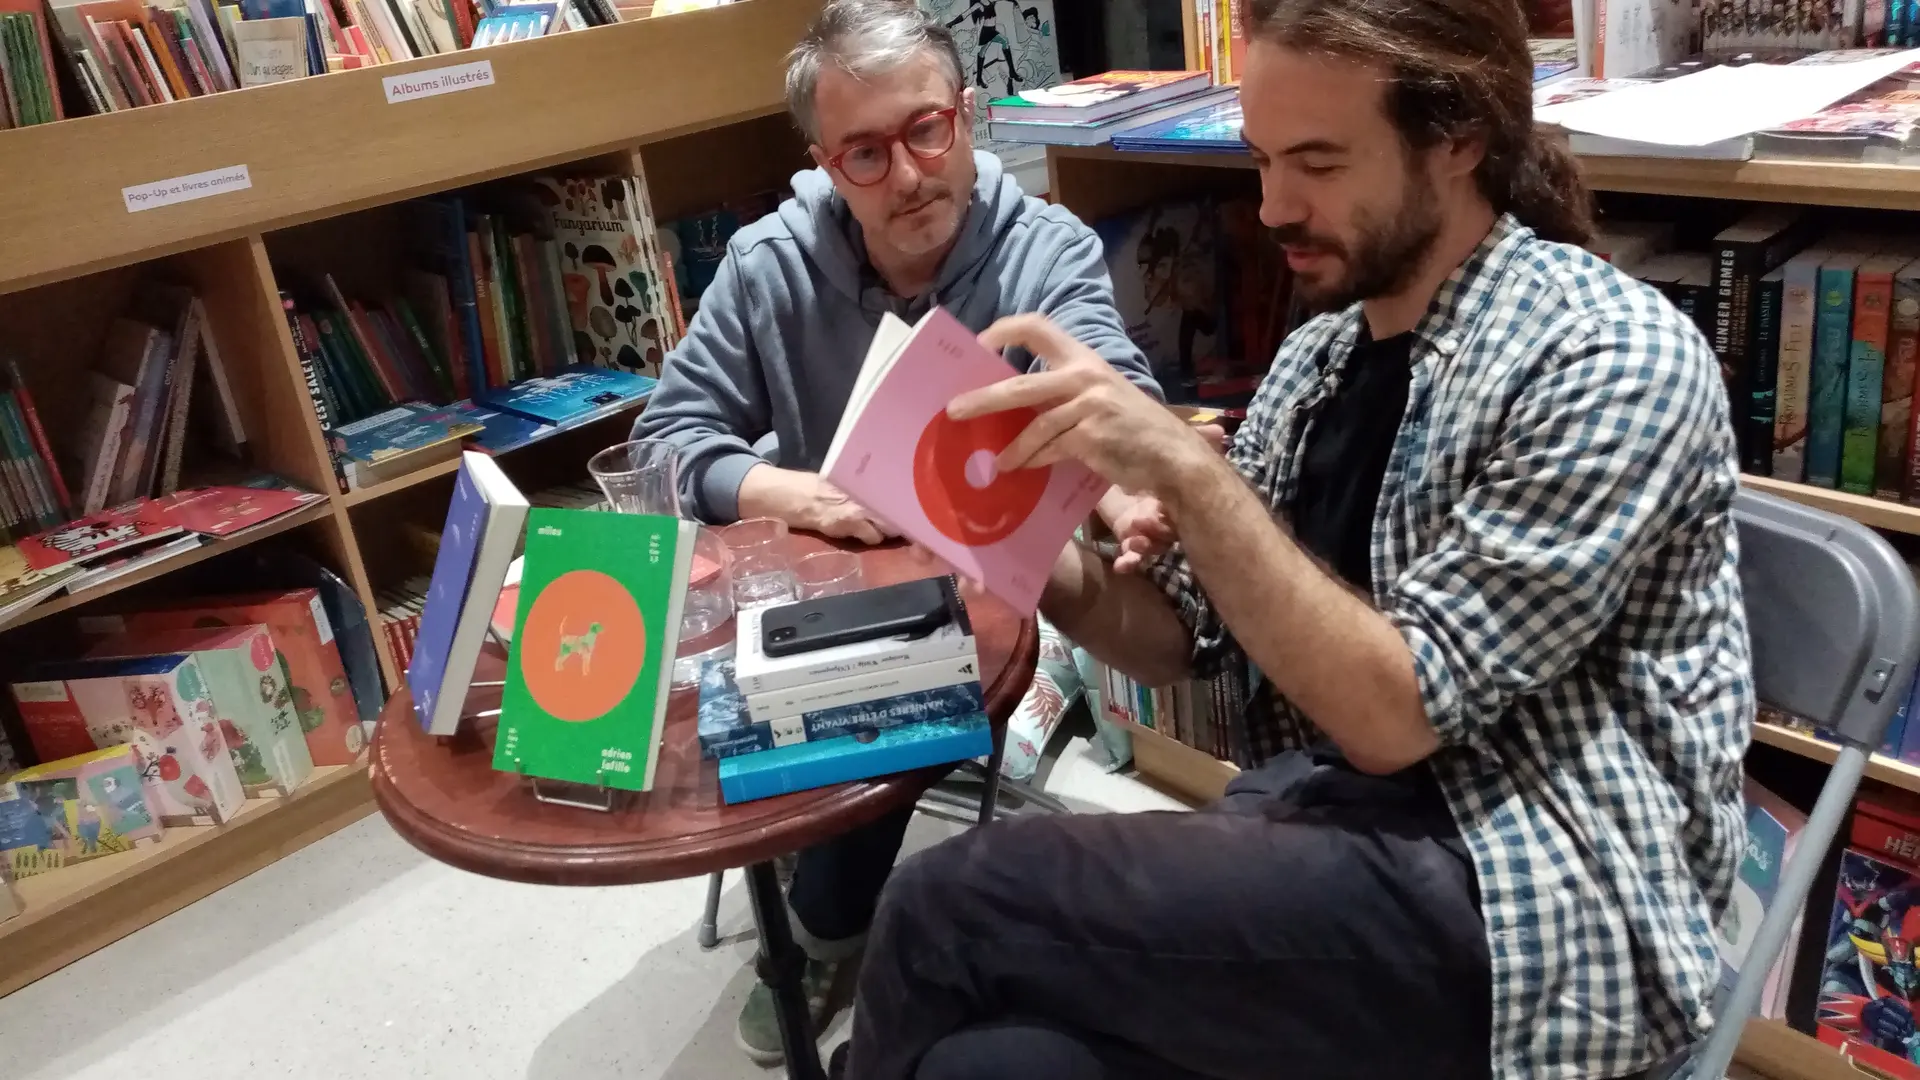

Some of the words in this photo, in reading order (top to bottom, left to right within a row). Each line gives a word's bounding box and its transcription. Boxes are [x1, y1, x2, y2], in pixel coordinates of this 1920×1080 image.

[391, 79, 440, 97] Albums
[440, 69, 491, 88] illustrés
[128, 188, 168, 203] Pop-Up
[170, 186, 182, 195] et
[182, 181, 209, 192] livres
[210, 172, 246, 186] animés
[553, 211, 626, 237] Fungarium
[1719, 249, 1735, 297] GAMES
[1714, 300, 1731, 353] HUNGER
[313, 394, 331, 431] C'EST
[601, 747, 632, 760] adrien
